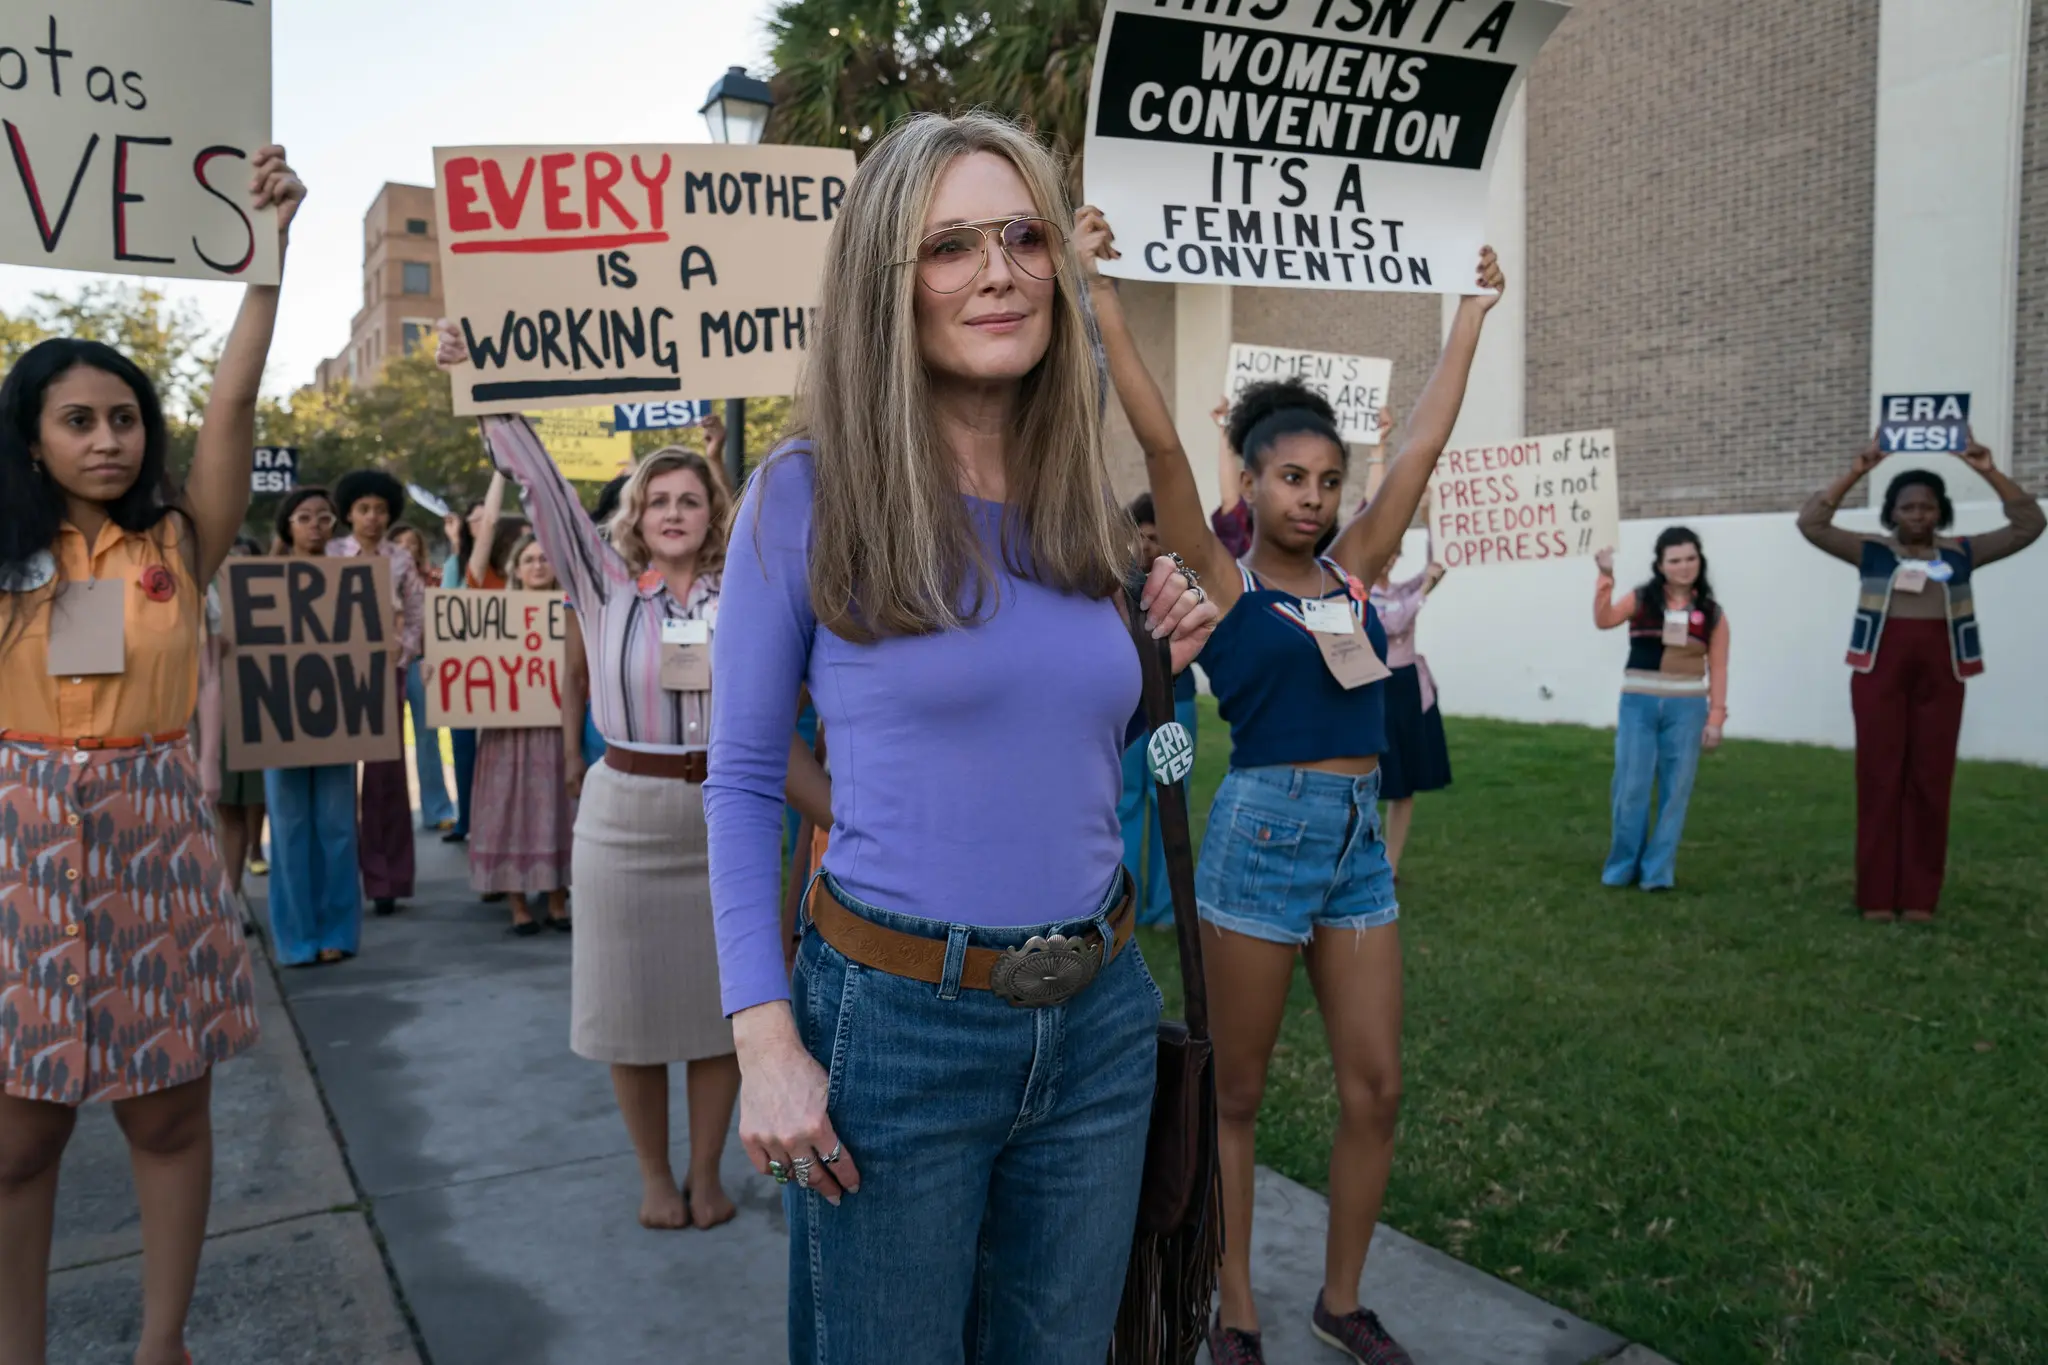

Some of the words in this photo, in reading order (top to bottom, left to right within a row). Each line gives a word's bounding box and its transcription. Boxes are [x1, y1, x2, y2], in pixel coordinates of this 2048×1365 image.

[1463, 0, 1515, 53] A
[86, 66, 147, 110] as
[1201, 31, 1427, 102] WOMENS
[1129, 82, 1460, 160] CONVENTION
[444, 152, 672, 232] EVERY
[684, 171, 847, 221] MOTHER
[1212, 152, 1308, 207] IT'S
[1335, 164, 1365, 213] A
[1163, 204, 1404, 252] FEMINIST
[597, 250, 637, 288] IS
[680, 246, 717, 289] A
[1144, 241, 1433, 285] CONVENTION
[461, 307, 681, 373] WORKING
[700, 307, 813, 358] MOTH
[1235, 350, 1360, 381] WOMEN'S
[619, 400, 702, 429] YES!
[1335, 385, 1381, 410] ARE
[1888, 396, 1962, 421] ERA
[255, 449, 293, 468] RA
[1434, 442, 1541, 476] FREEDOM
[1552, 438, 1572, 461] of
[1579, 437, 1611, 460] the
[1884, 425, 1960, 450] YES!
[252, 471, 292, 491] ES!
[1438, 474, 1519, 510] PRESS
[1534, 475, 1554, 498] is
[1561, 466, 1599, 495] not
[1438, 503, 1557, 539] FREEDOM
[1569, 499, 1592, 523] to
[1444, 529, 1568, 567] OPPRESS
[229, 561, 386, 646] ERA
[434, 595, 517, 641] EQUAL
[238, 649, 386, 745] NOW
[439, 654, 523, 713] PAY
[1149, 722, 1189, 767] ERA
[1154, 746, 1193, 786] YES
